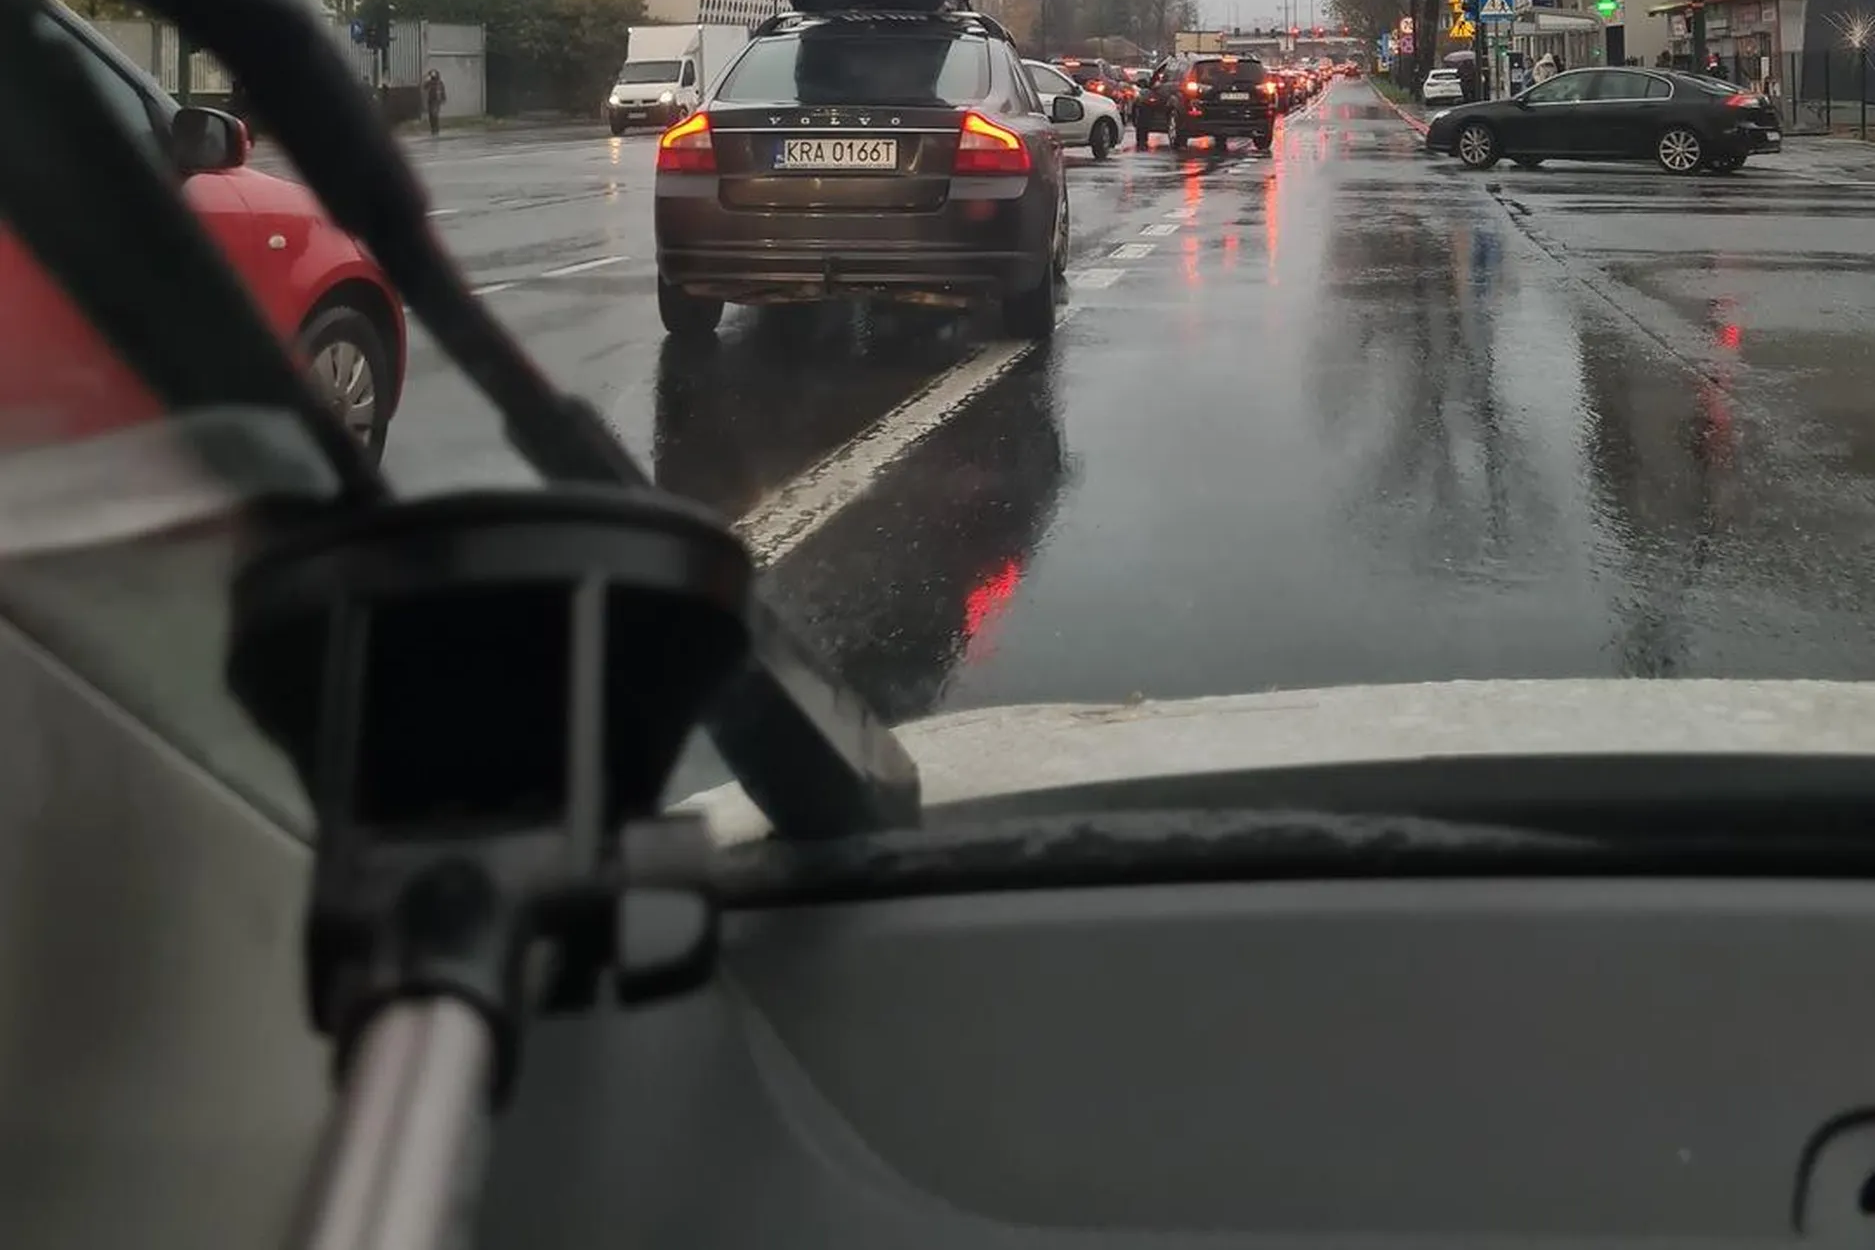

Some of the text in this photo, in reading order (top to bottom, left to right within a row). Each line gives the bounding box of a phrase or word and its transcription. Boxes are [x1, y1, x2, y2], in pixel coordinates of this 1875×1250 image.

[769, 116, 900, 126] VOLVO
[786, 141, 894, 162] KRA 0166T
